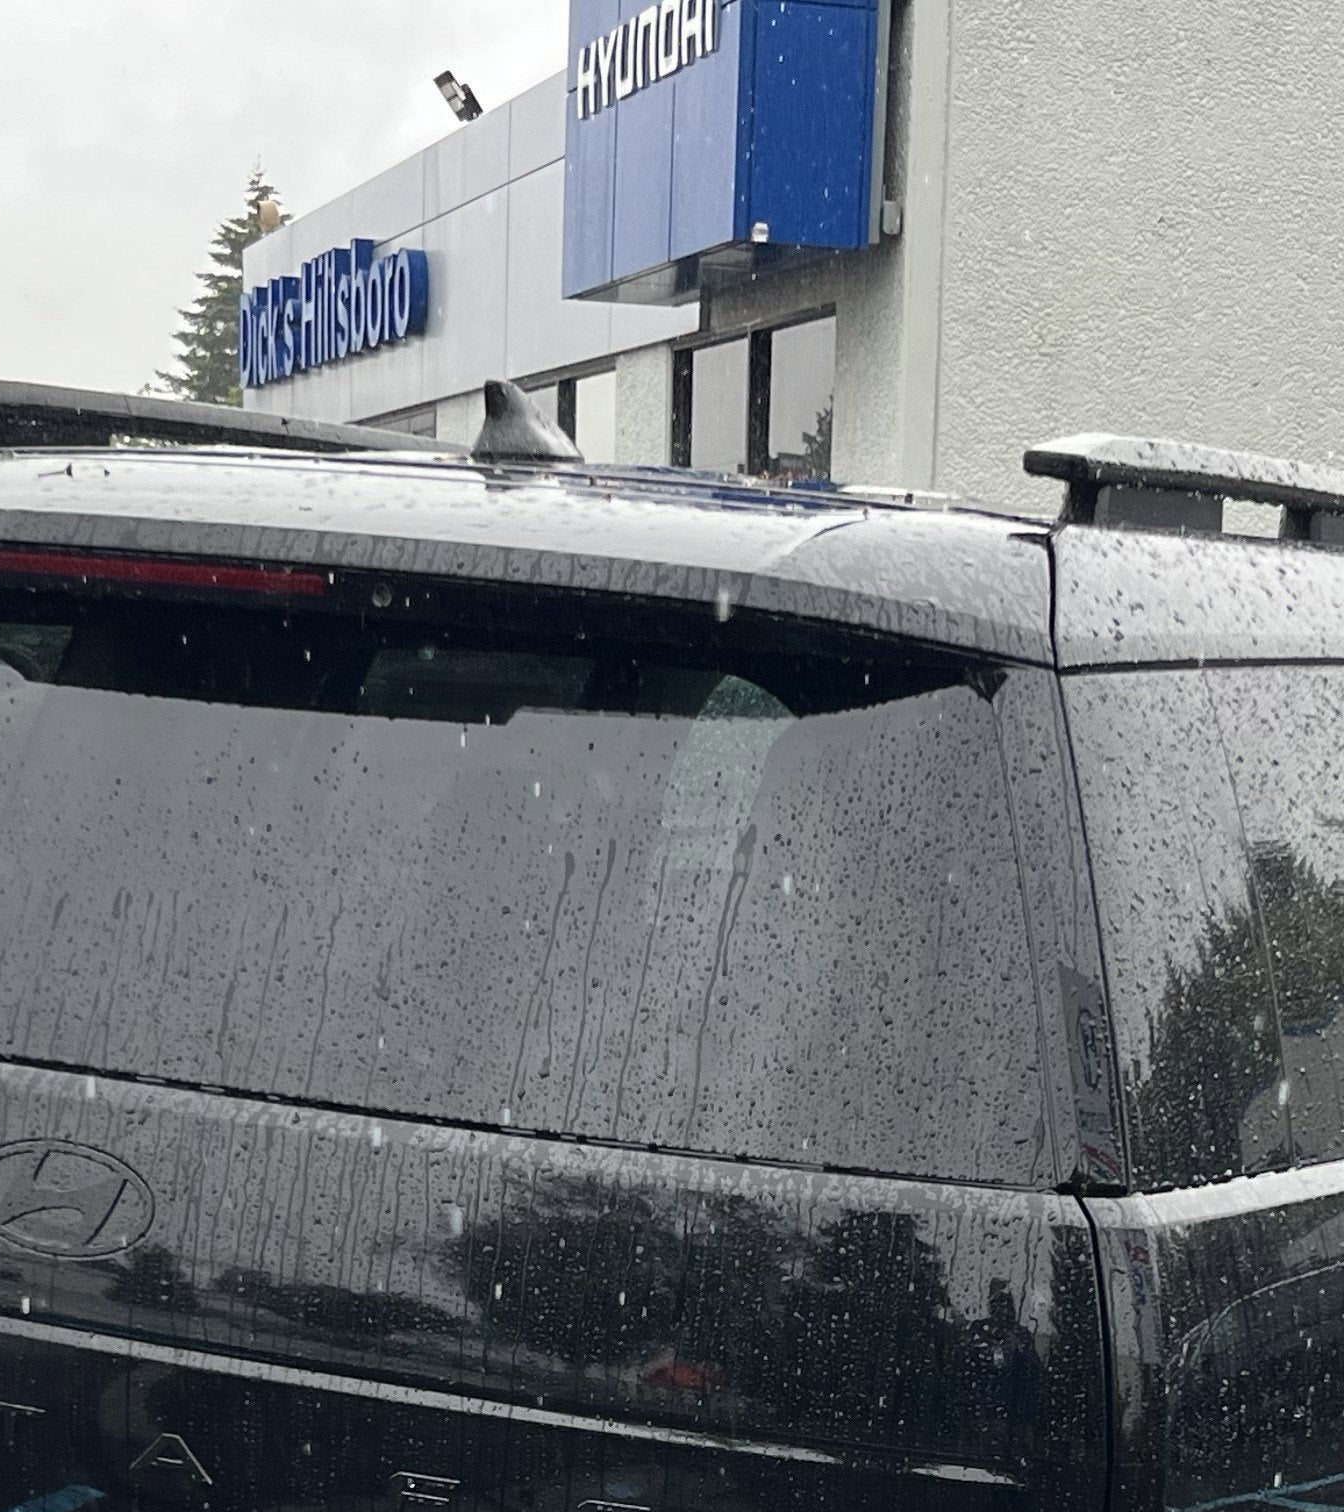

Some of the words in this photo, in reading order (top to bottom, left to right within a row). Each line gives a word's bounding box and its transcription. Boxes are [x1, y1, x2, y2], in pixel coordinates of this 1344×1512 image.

[577, 0, 715, 119] HYUNDAI
[240, 276, 295, 389] Dick's
[300, 238, 414, 369] Hillsboro
